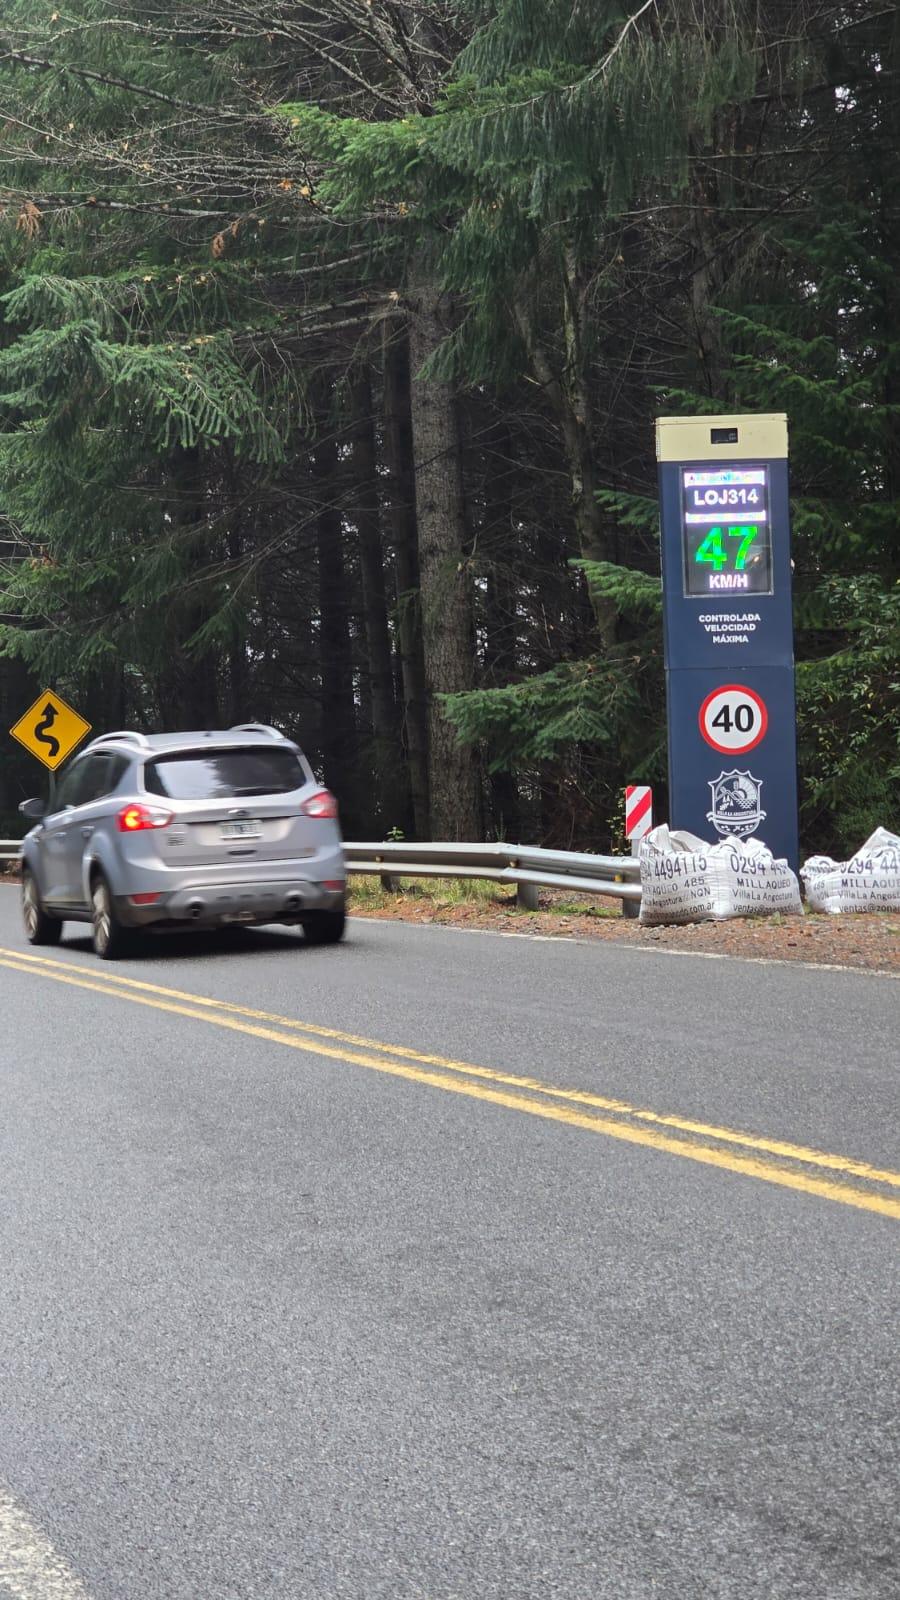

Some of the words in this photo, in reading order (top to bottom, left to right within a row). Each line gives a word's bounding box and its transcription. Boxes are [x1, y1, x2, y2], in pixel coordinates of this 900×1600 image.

[694, 488, 759, 506] LOJ314
[695, 526, 758, 571] 47
[709, 574, 748, 588] KM/H
[698, 613, 761, 622] CONTROLADA
[704, 623, 756, 631] VELOCIDAD
[712, 634, 749, 643] MÁXIMA
[712, 704, 755, 732] 40
[880, 856, 900, 874] 44
